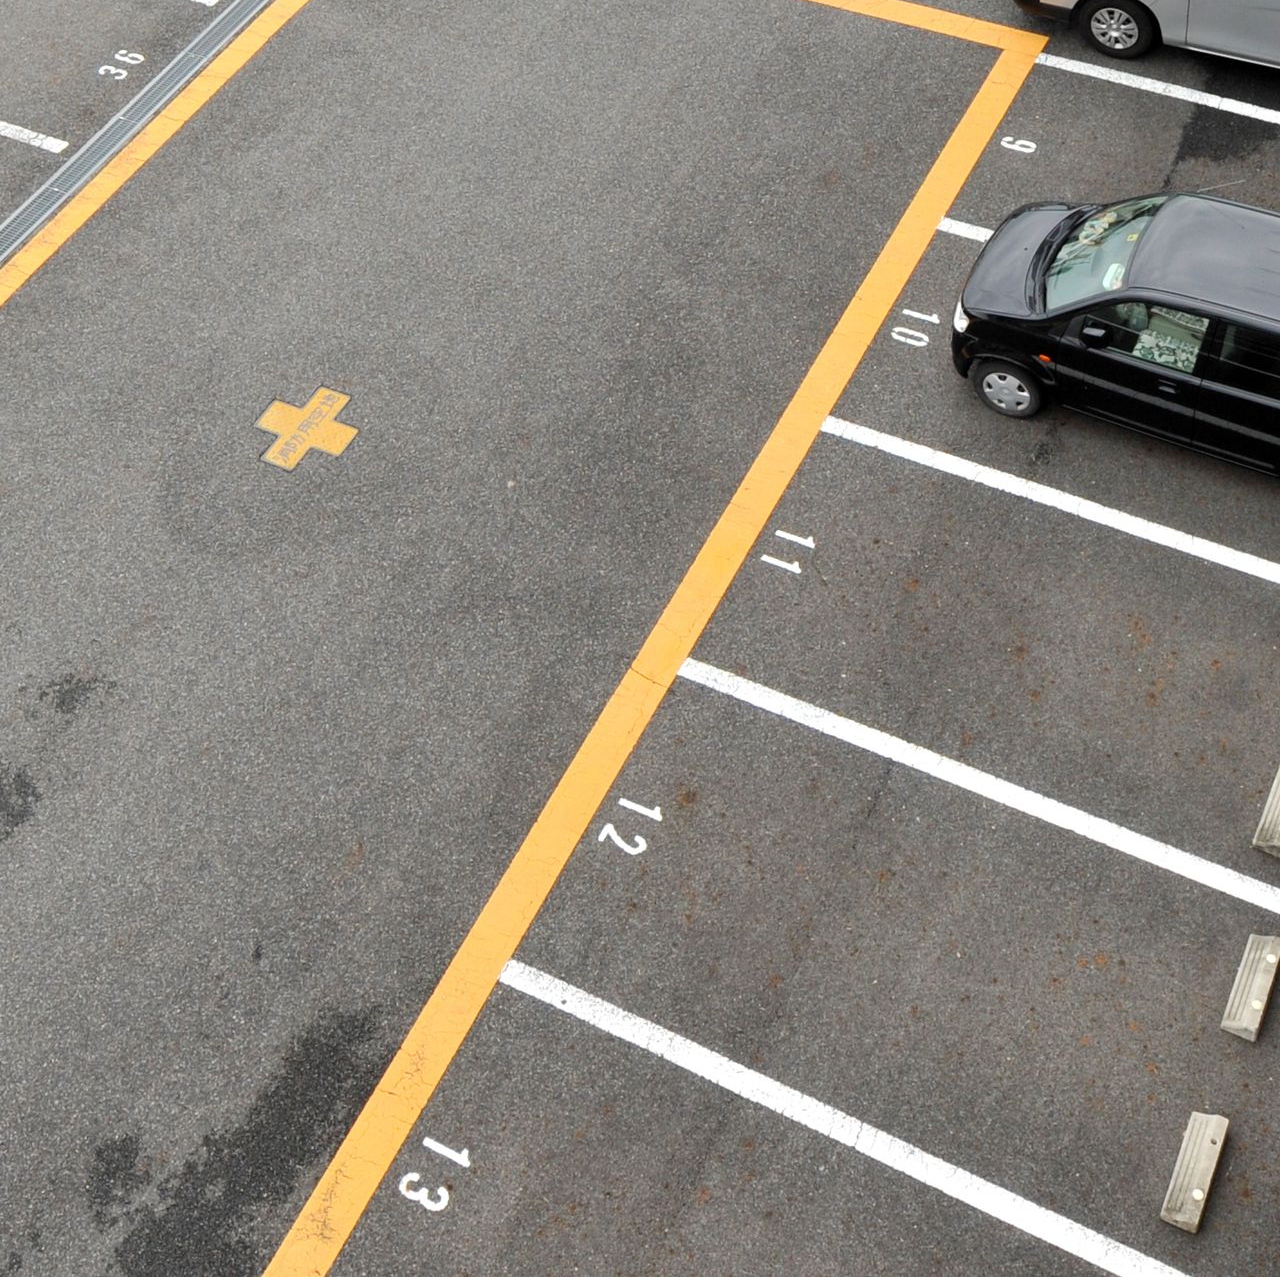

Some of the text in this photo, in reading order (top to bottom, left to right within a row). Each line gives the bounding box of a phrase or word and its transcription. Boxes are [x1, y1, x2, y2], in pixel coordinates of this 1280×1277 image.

[98, 49, 145, 80] 36
[999, 135, 1037, 154] 9
[890, 307, 941, 348] 10
[760, 529, 815, 574] 11
[597, 797, 663, 856] 12
[398, 1136, 471, 1212] 13
